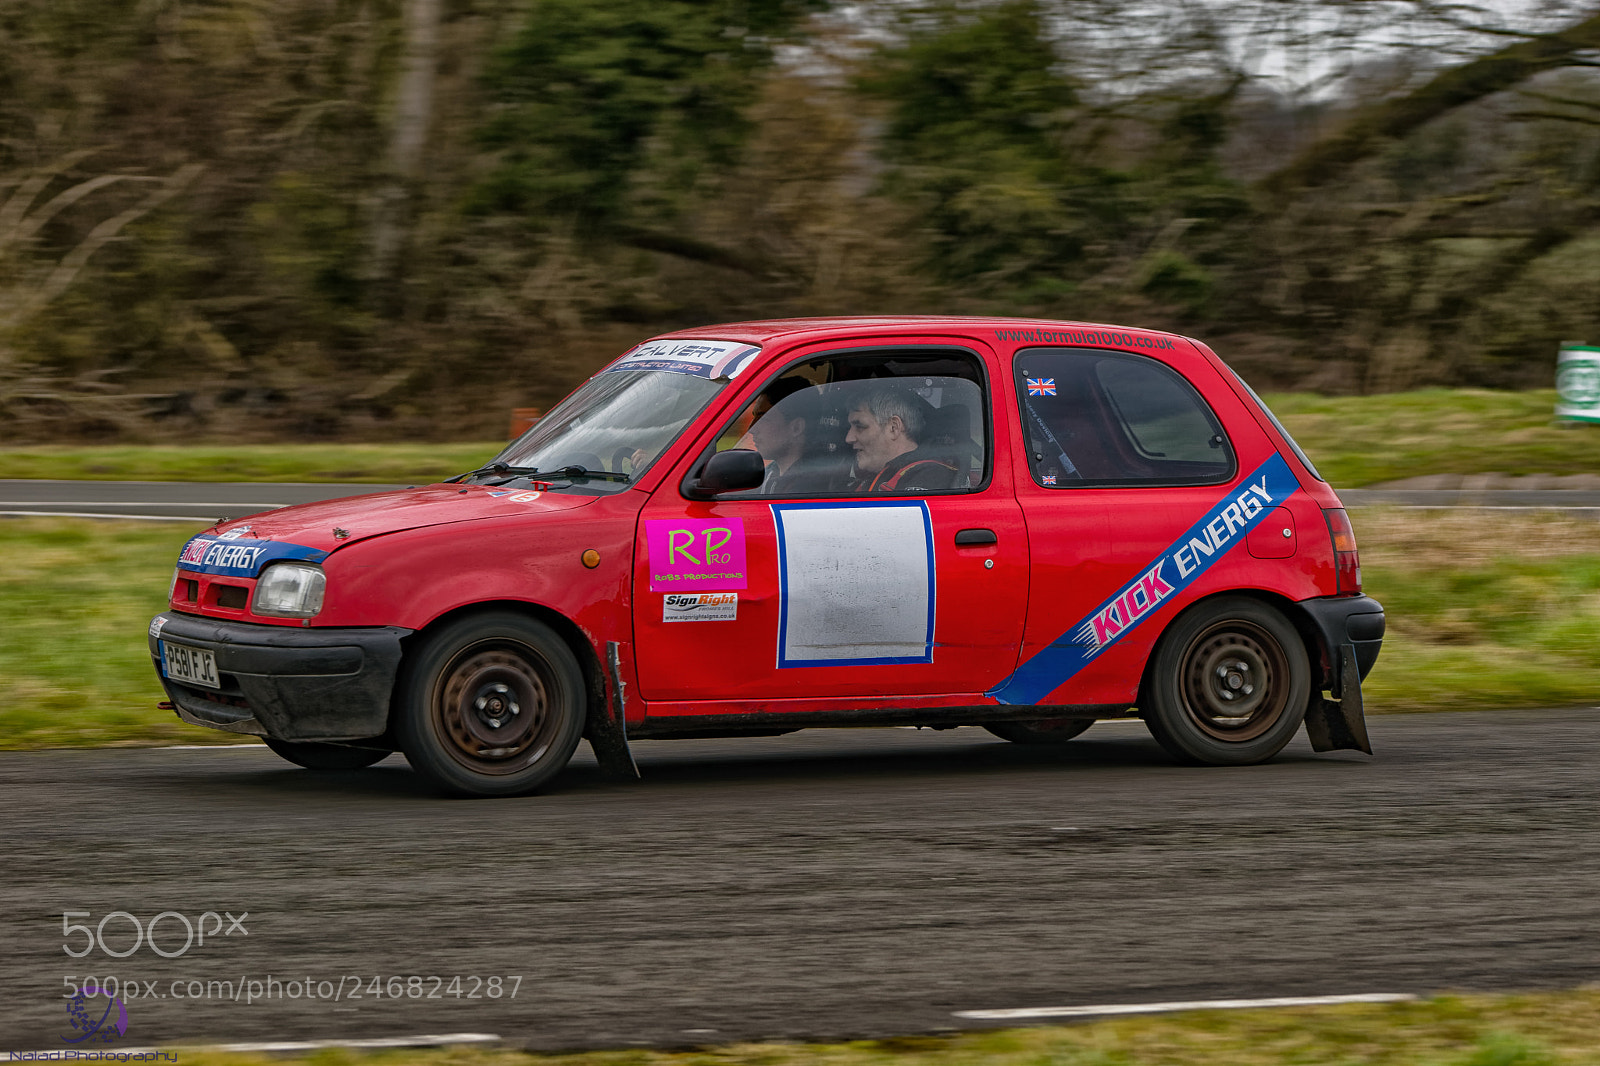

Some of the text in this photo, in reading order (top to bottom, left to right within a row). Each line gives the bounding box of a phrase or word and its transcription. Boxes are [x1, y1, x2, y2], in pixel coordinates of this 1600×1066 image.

[994, 328, 1175, 350] www.formula1000.co.uk
[633, 345, 726, 359] CALVERT
[204, 544, 267, 569] ENERGY
[1090, 475, 1273, 648] KICK ENERGY
